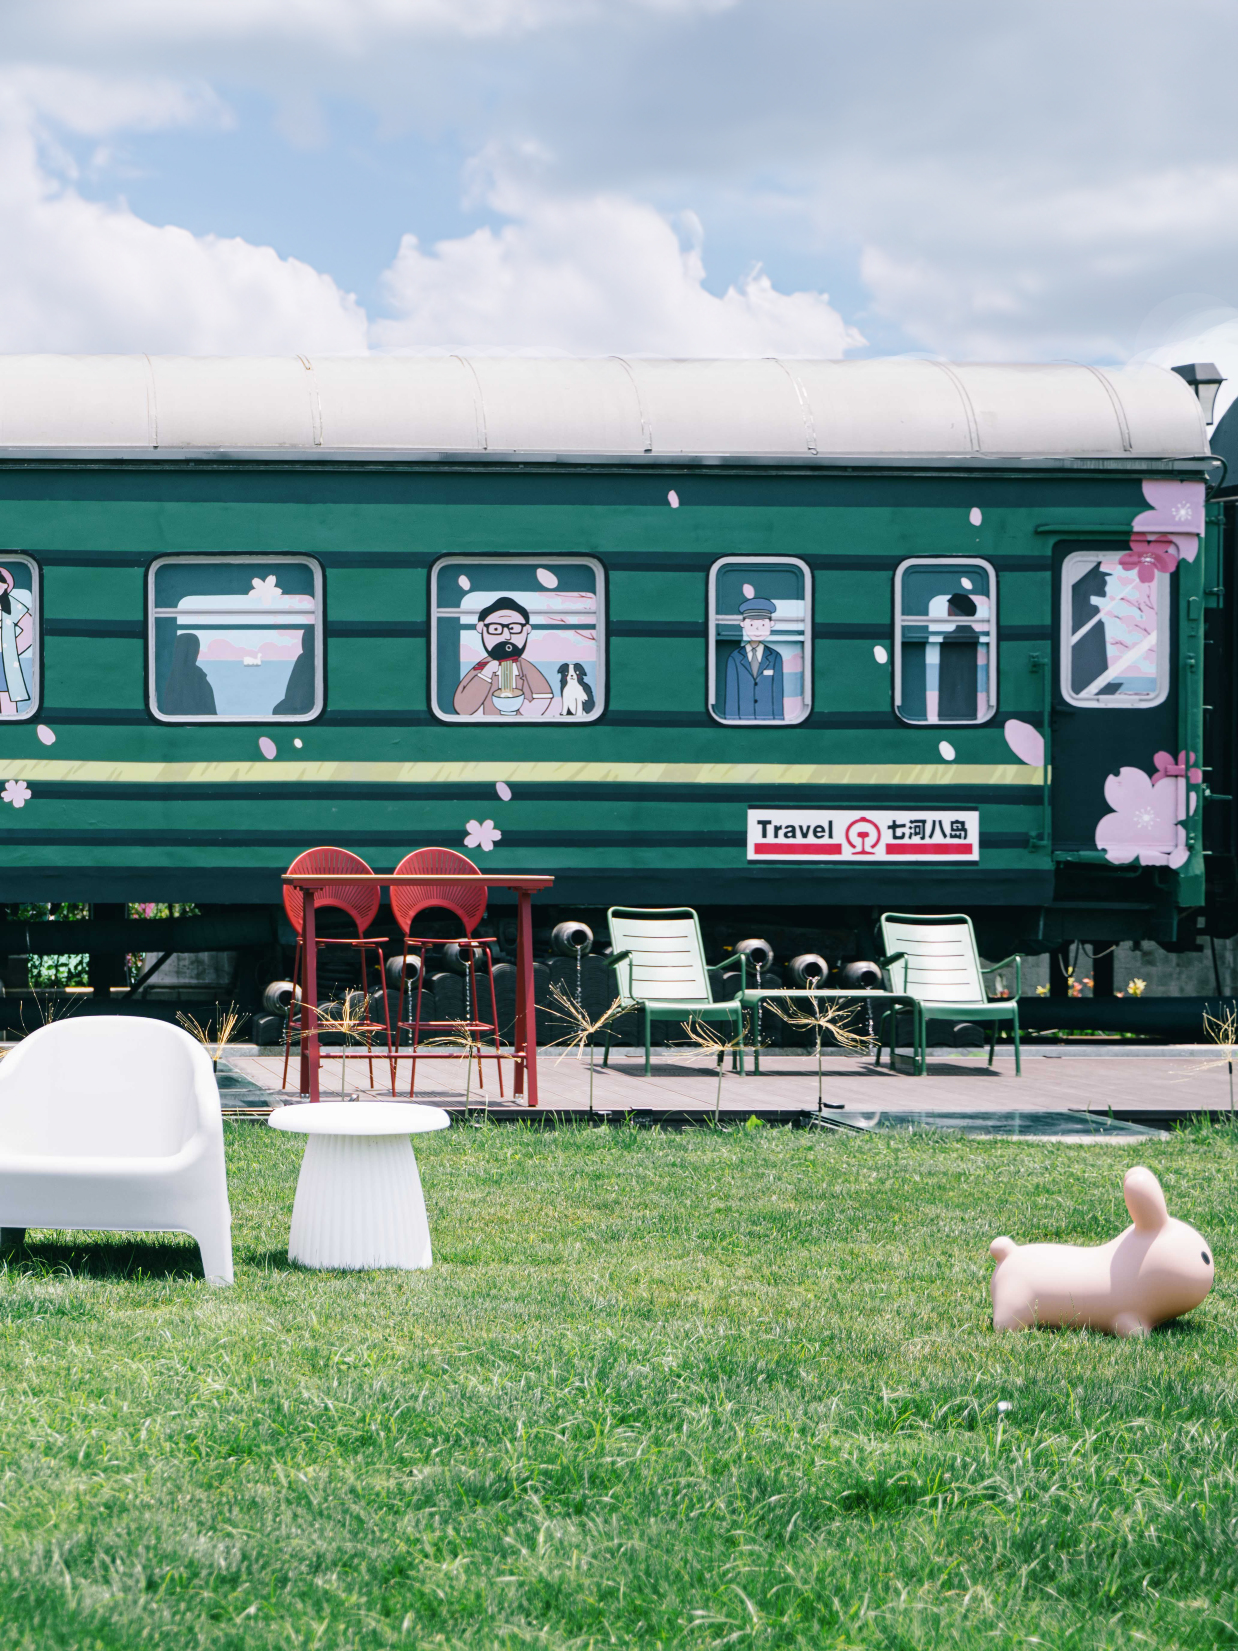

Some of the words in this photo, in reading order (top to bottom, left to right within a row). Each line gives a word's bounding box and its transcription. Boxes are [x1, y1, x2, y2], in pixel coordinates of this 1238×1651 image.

[757, 819, 834, 840] Travel
[887, 818, 969, 841] 七河八岛
